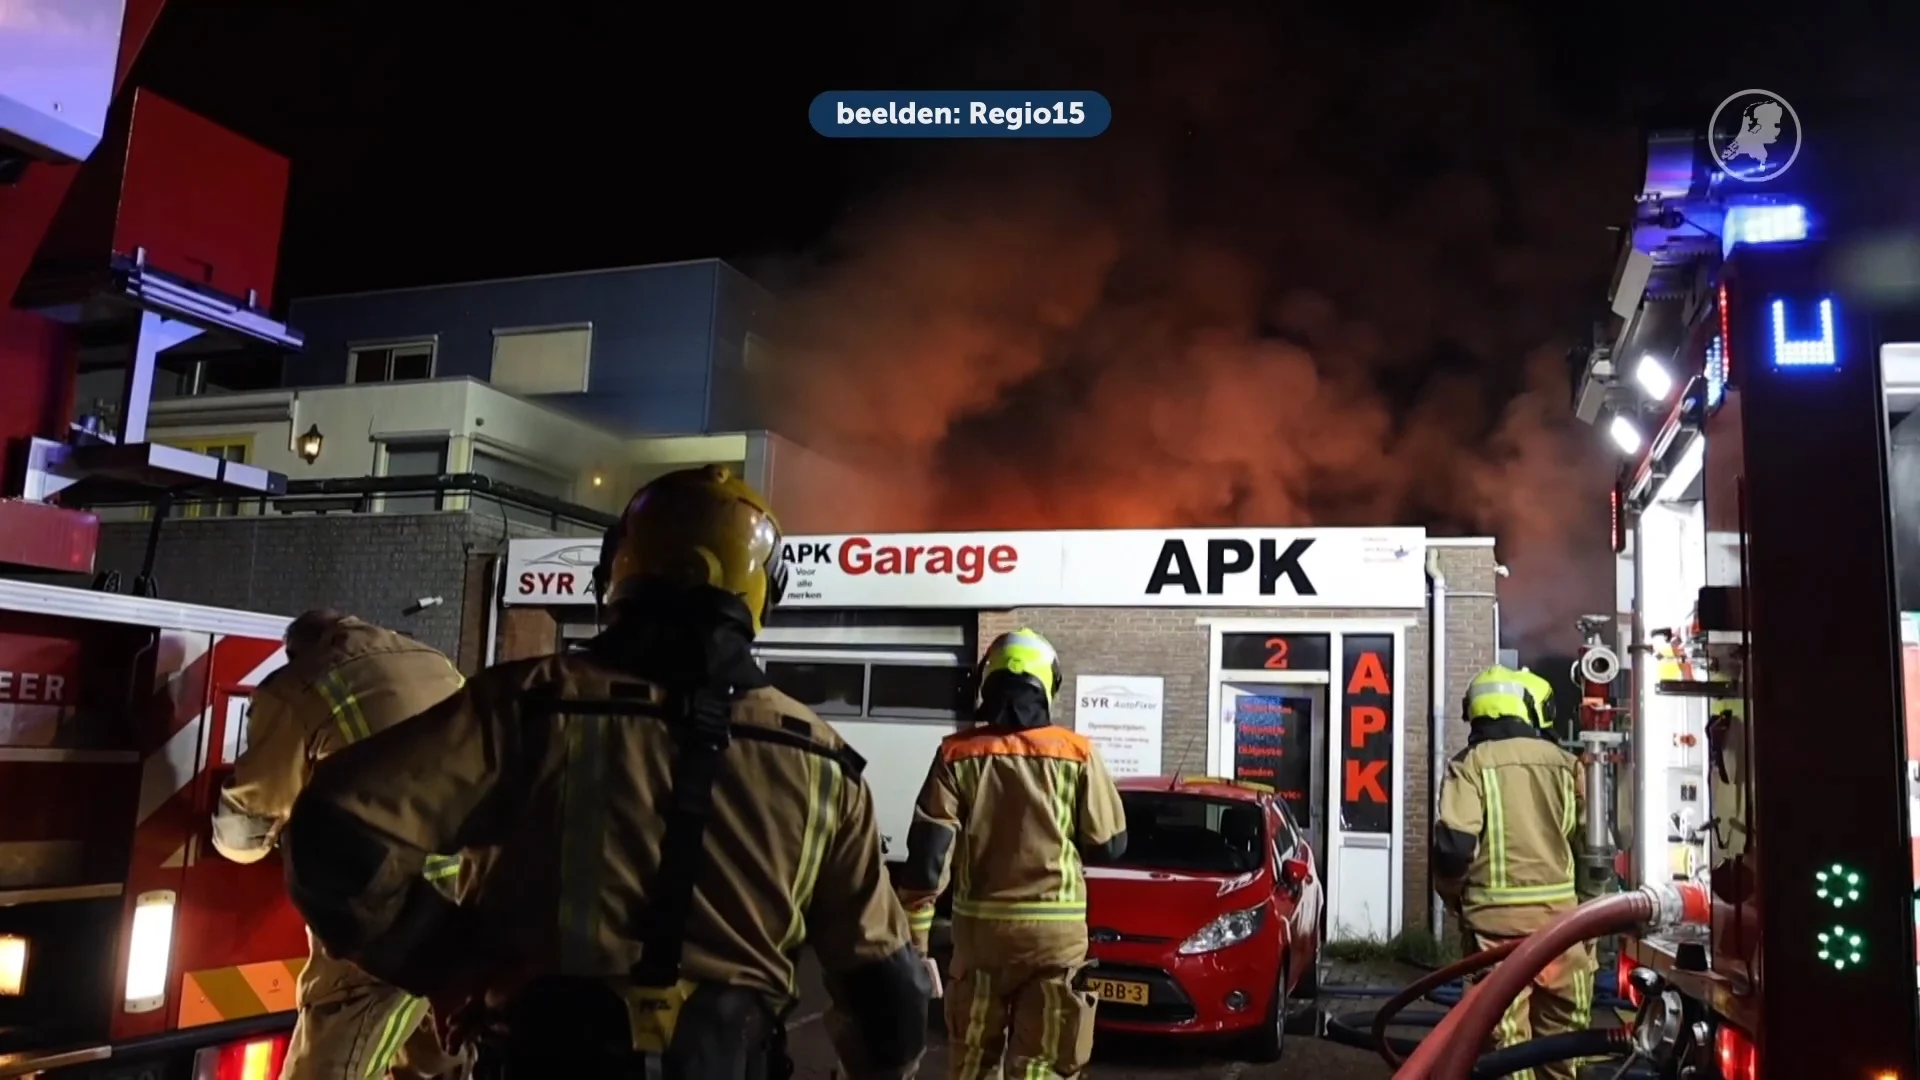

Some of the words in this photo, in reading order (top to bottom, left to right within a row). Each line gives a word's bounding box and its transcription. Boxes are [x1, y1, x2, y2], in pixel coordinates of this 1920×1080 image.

[782, 543, 832, 564] APK
[838, 537, 1018, 584] Garage
[796, 567, 816, 576] Voor
[1144, 538, 1318, 596] APK
[519, 572, 574, 595] SYR
[797, 580, 813, 588] alle
[788, 592, 822, 600] merken
[1264, 638, 1288, 669] 2
[1081, 697, 1109, 708] SYR
